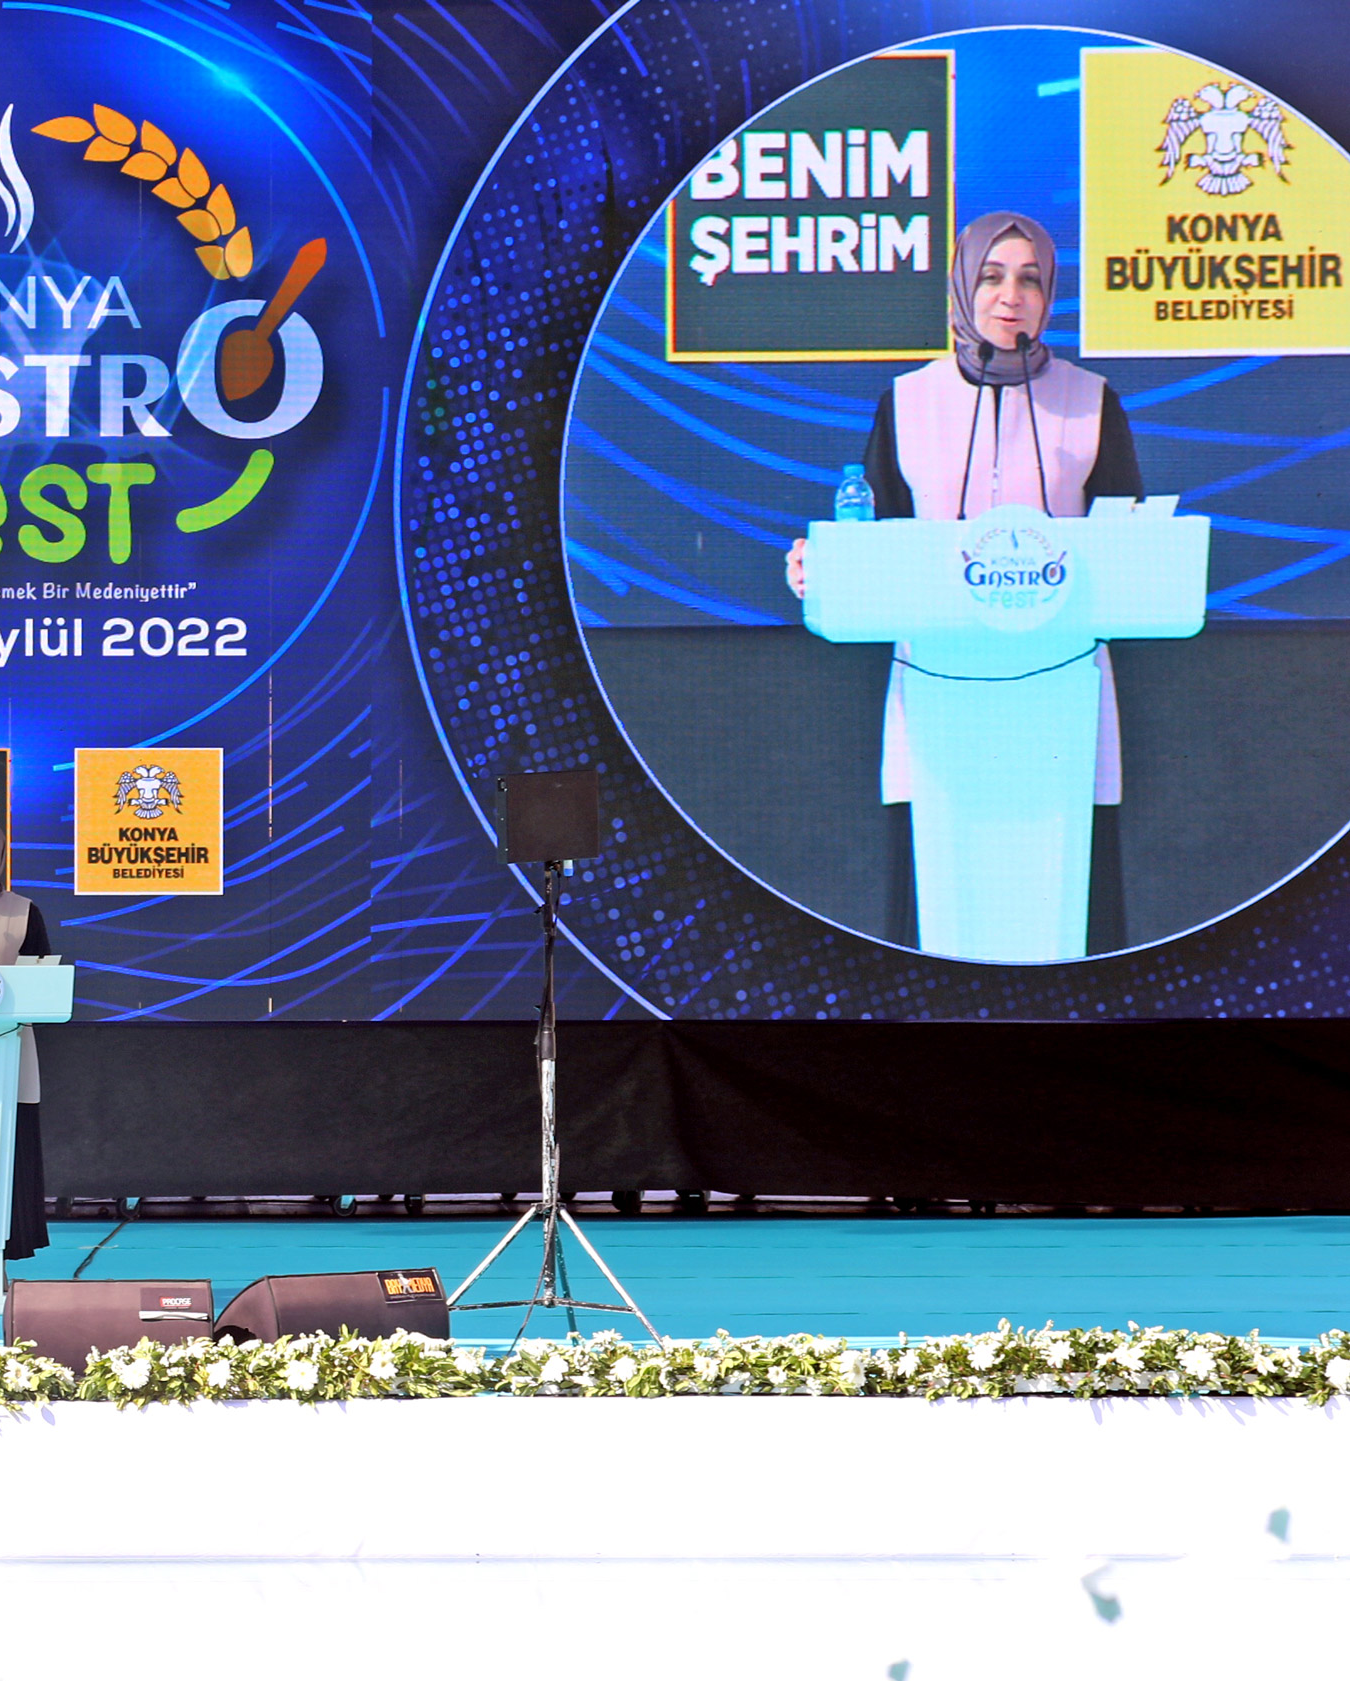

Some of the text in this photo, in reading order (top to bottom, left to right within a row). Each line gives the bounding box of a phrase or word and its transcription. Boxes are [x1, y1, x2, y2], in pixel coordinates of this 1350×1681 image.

[1166, 213, 1282, 245] KONYA
[1106, 245, 1343, 294] BÜYÜKŞEHİR
[1154, 294, 1294, 323] BELEDİYESİ
[42, 582, 70, 600] Bir
[102, 617, 248, 657] 2022
[119, 827, 178, 842] KONYA
[87, 842, 209, 865] BÜYÜKŞEHİR
[113, 866, 185, 879] BELEDİYESİ
